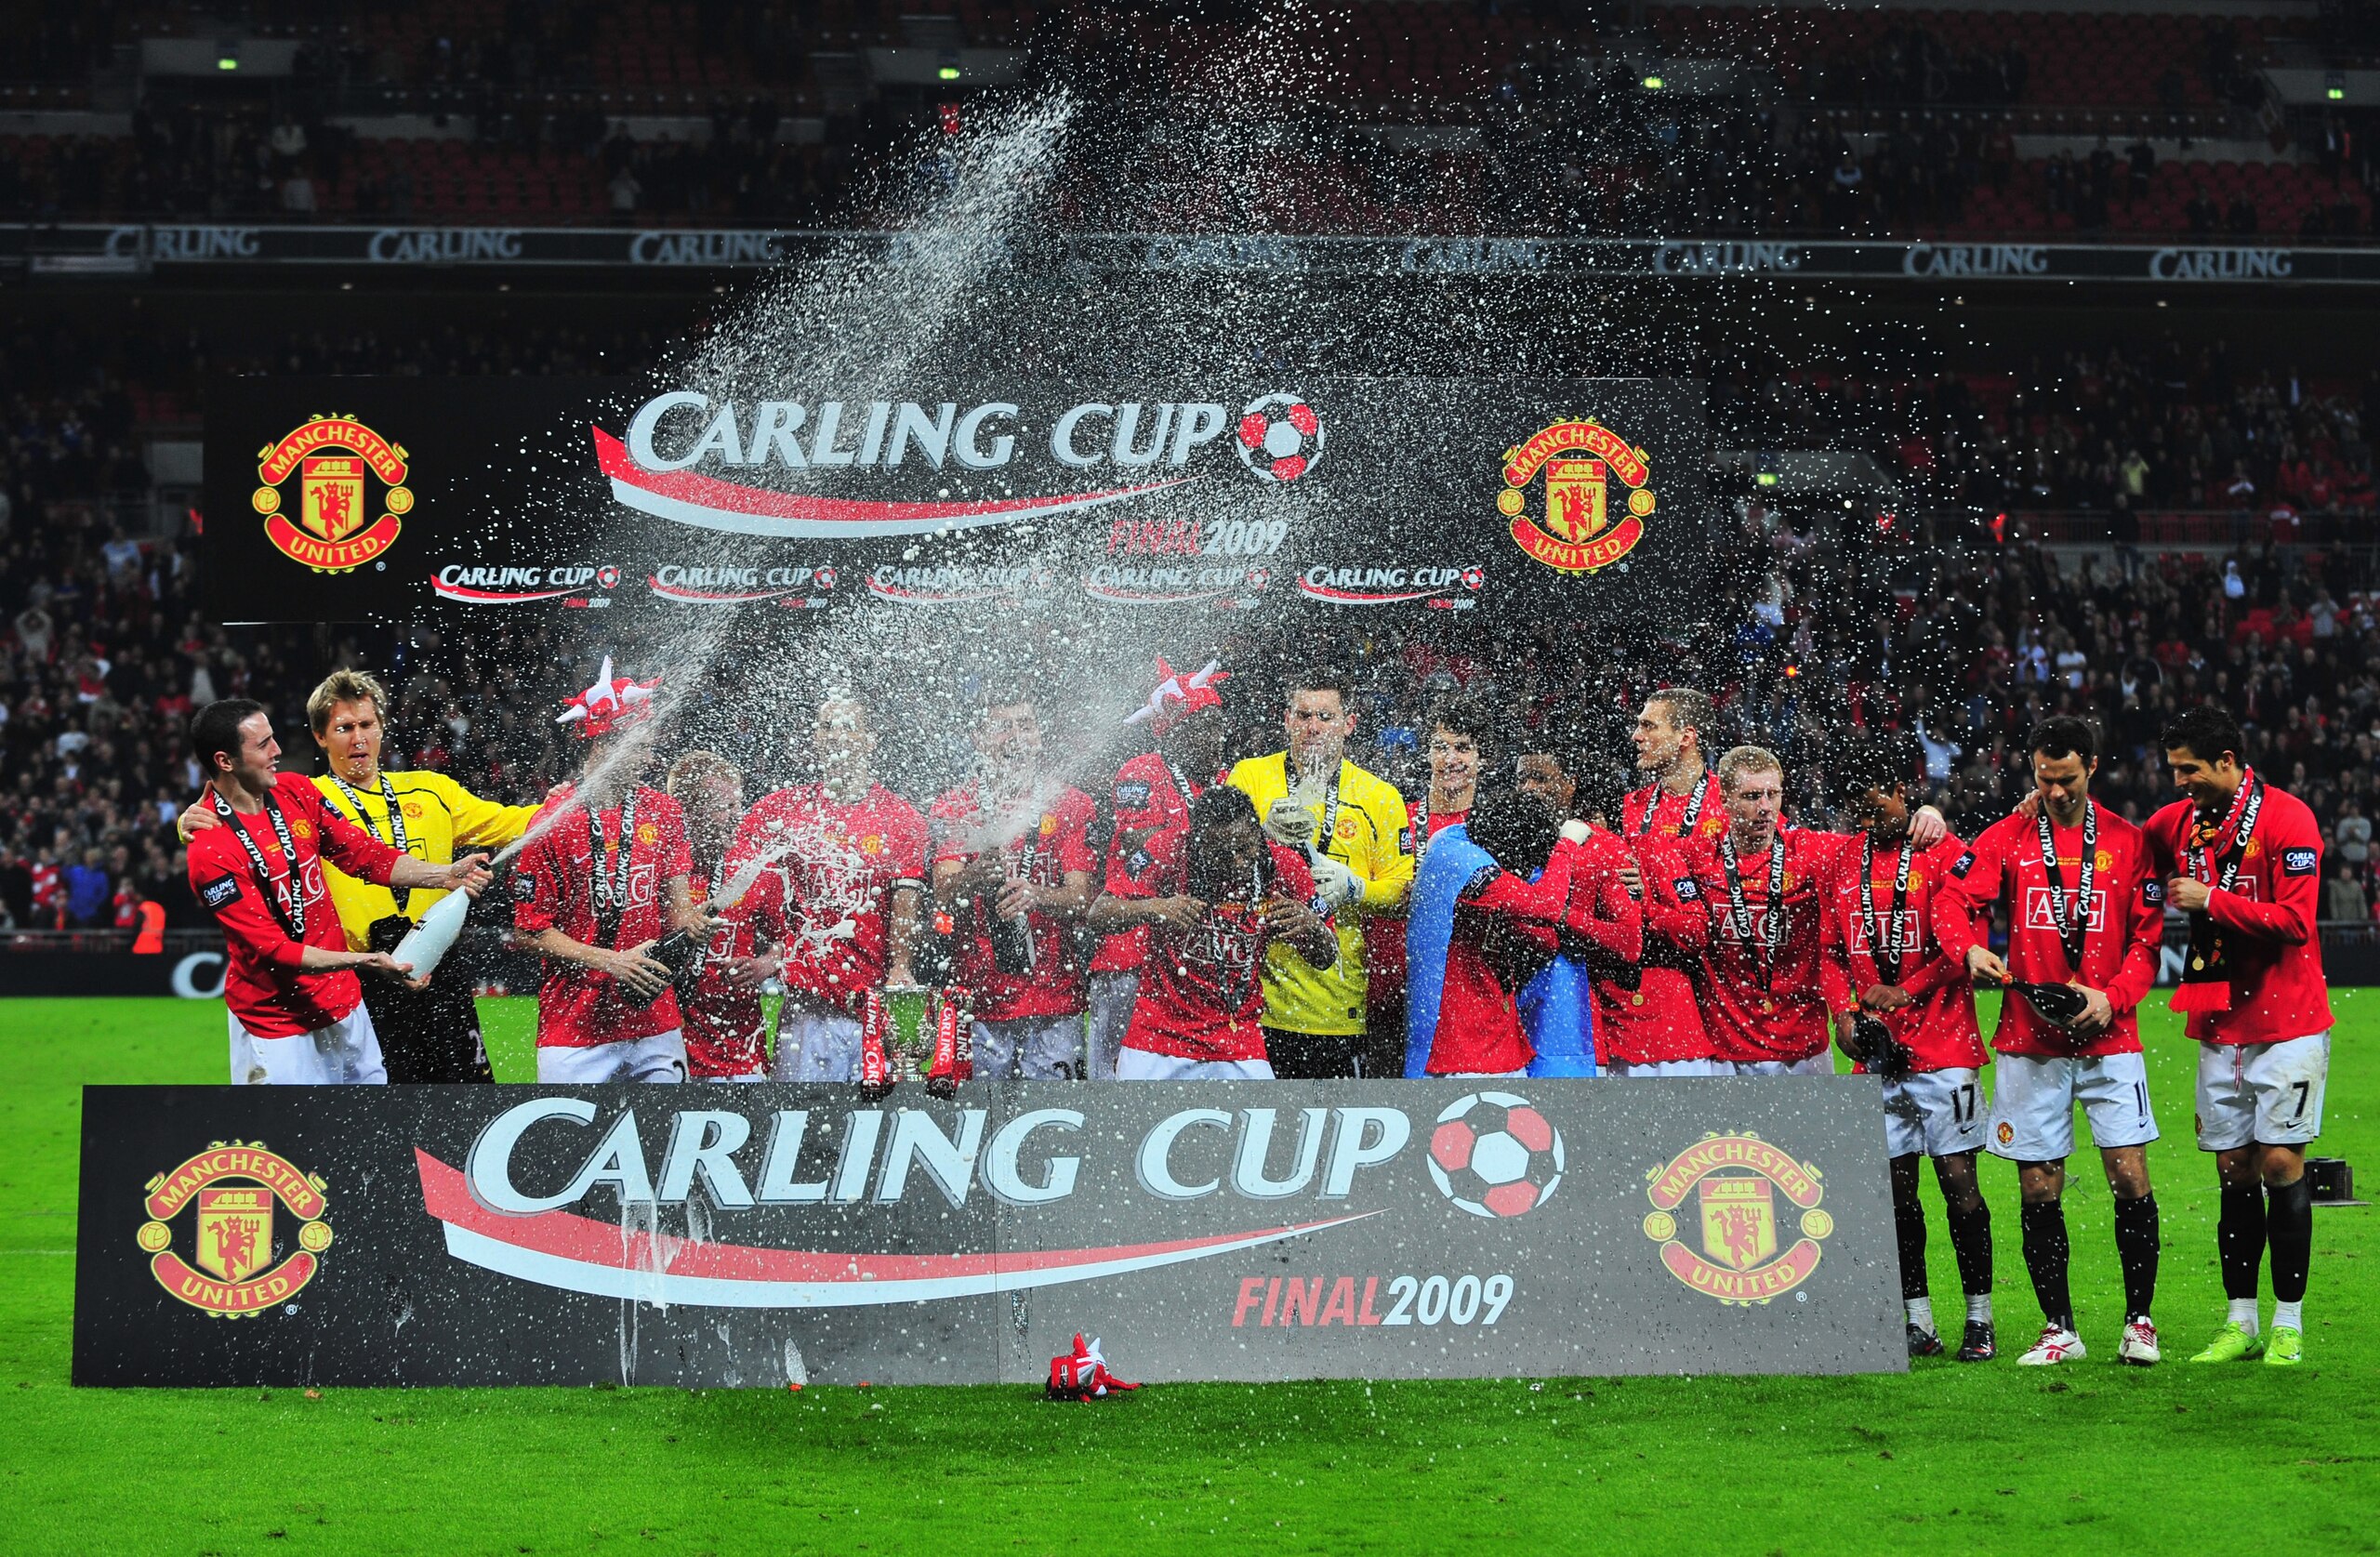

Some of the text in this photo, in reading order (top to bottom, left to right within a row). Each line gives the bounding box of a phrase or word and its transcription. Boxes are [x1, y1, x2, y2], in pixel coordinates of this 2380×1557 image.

[104, 227, 260, 259] CRLING
[368, 230, 523, 262] CARLING
[629, 231, 783, 264] CARLING
[1653, 240, 1801, 275] CARLING
[1902, 243, 2047, 277] CARLING
[2149, 248, 2293, 280] CARLING
[270, 425, 397, 477] MANCHESTER
[625, 390, 1227, 472] CARLING CUP
[1514, 428, 1639, 479] MANCHESTER
[289, 535, 378, 563] UNITED
[1534, 537, 1621, 566] UNITED
[439, 564, 596, 587] CARLING CUP
[656, 564, 813, 587] CARLING CUP
[1305, 565, 1461, 587] CARLING CUP
[1323, 784, 1339, 838] CARLING
[1684, 777, 1708, 826] CARLING
[2235, 794, 2263, 848] CARLING
[236, 828, 270, 878] CARLING
[270, 809, 297, 861] CARLING
[2037, 815, 2057, 867] CARLING
[204, 877, 234, 898] CARLING
[277, 864, 325, 909] AG
[594, 851, 607, 909] CARLING
[612, 851, 632, 908] CARLING
[1769, 843, 1784, 893] CARLING
[1895, 839, 1912, 892] CARLING
[2078, 861, 2094, 917] CARLING
[2292, 860, 2309, 868] CUP
[208, 891, 223, 904] CUP
[292, 878, 307, 934] CARLING
[1730, 886, 1752, 938] CARLING
[1861, 883, 1876, 937] CARLING
[2050, 885, 2069, 939] CARLING
[1767, 910, 1779, 964] CARLING
[1889, 909, 1905, 965] CARLING
[938, 1007, 954, 1062] CARLING
[1952, 1081, 1976, 1125] 17
[2134, 1078, 2147, 1117] 11
[2291, 1079, 2310, 1119] 7
[159, 1153, 313, 1210] MANCHESTER
[466, 1097, 1413, 1217] CARLING CUP
[1660, 1143, 1810, 1199] MANCHESTER
[180, 1276, 289, 1307] UNITED
[1691, 1263, 1796, 1295] UNITED
